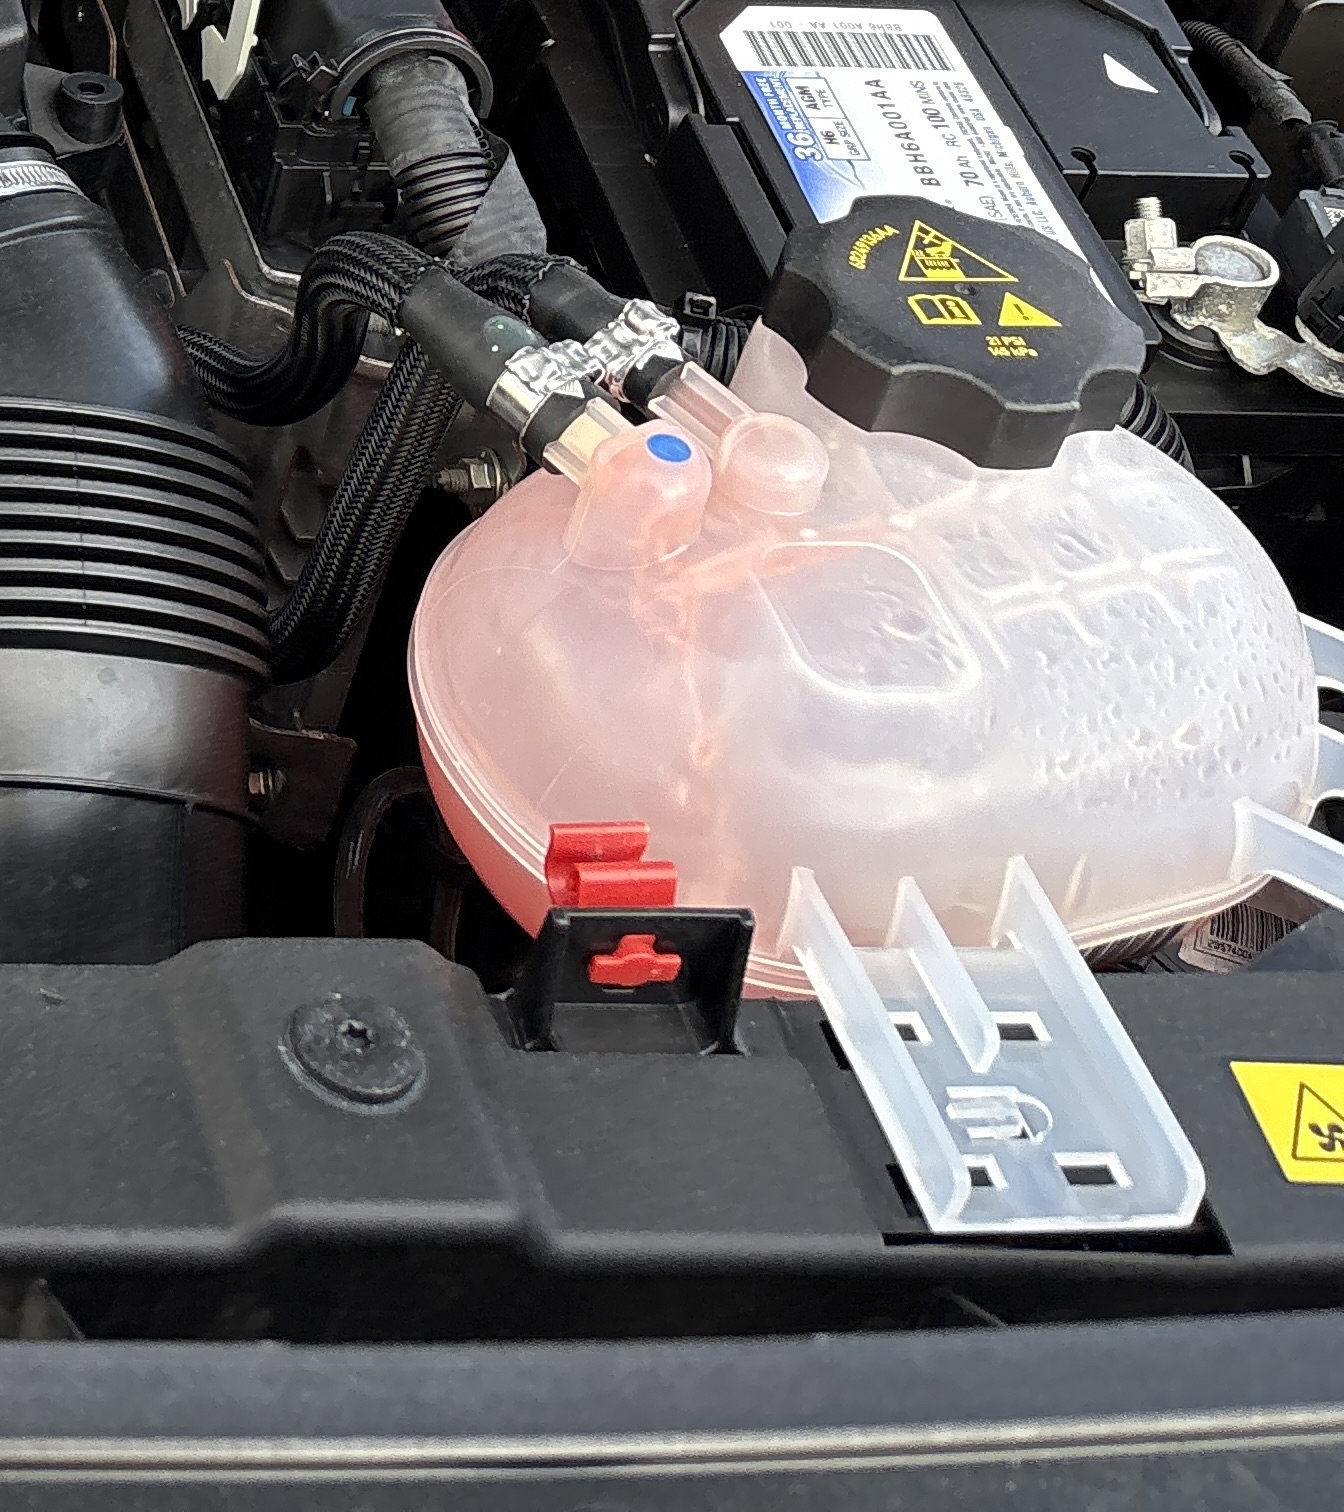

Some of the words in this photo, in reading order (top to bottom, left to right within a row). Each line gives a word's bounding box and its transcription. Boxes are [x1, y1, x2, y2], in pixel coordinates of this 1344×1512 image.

[755, 77, 774, 96] FREE
[795, 86, 821, 110] AGM
[767, 97, 794, 129] MONTH
[922, 108, 950, 129] 100
[786, 132, 824, 161] 36
[820, 131, 839, 144] H6
[960, 172, 984, 187] 70
[1003, 336, 1026, 346] PSI
